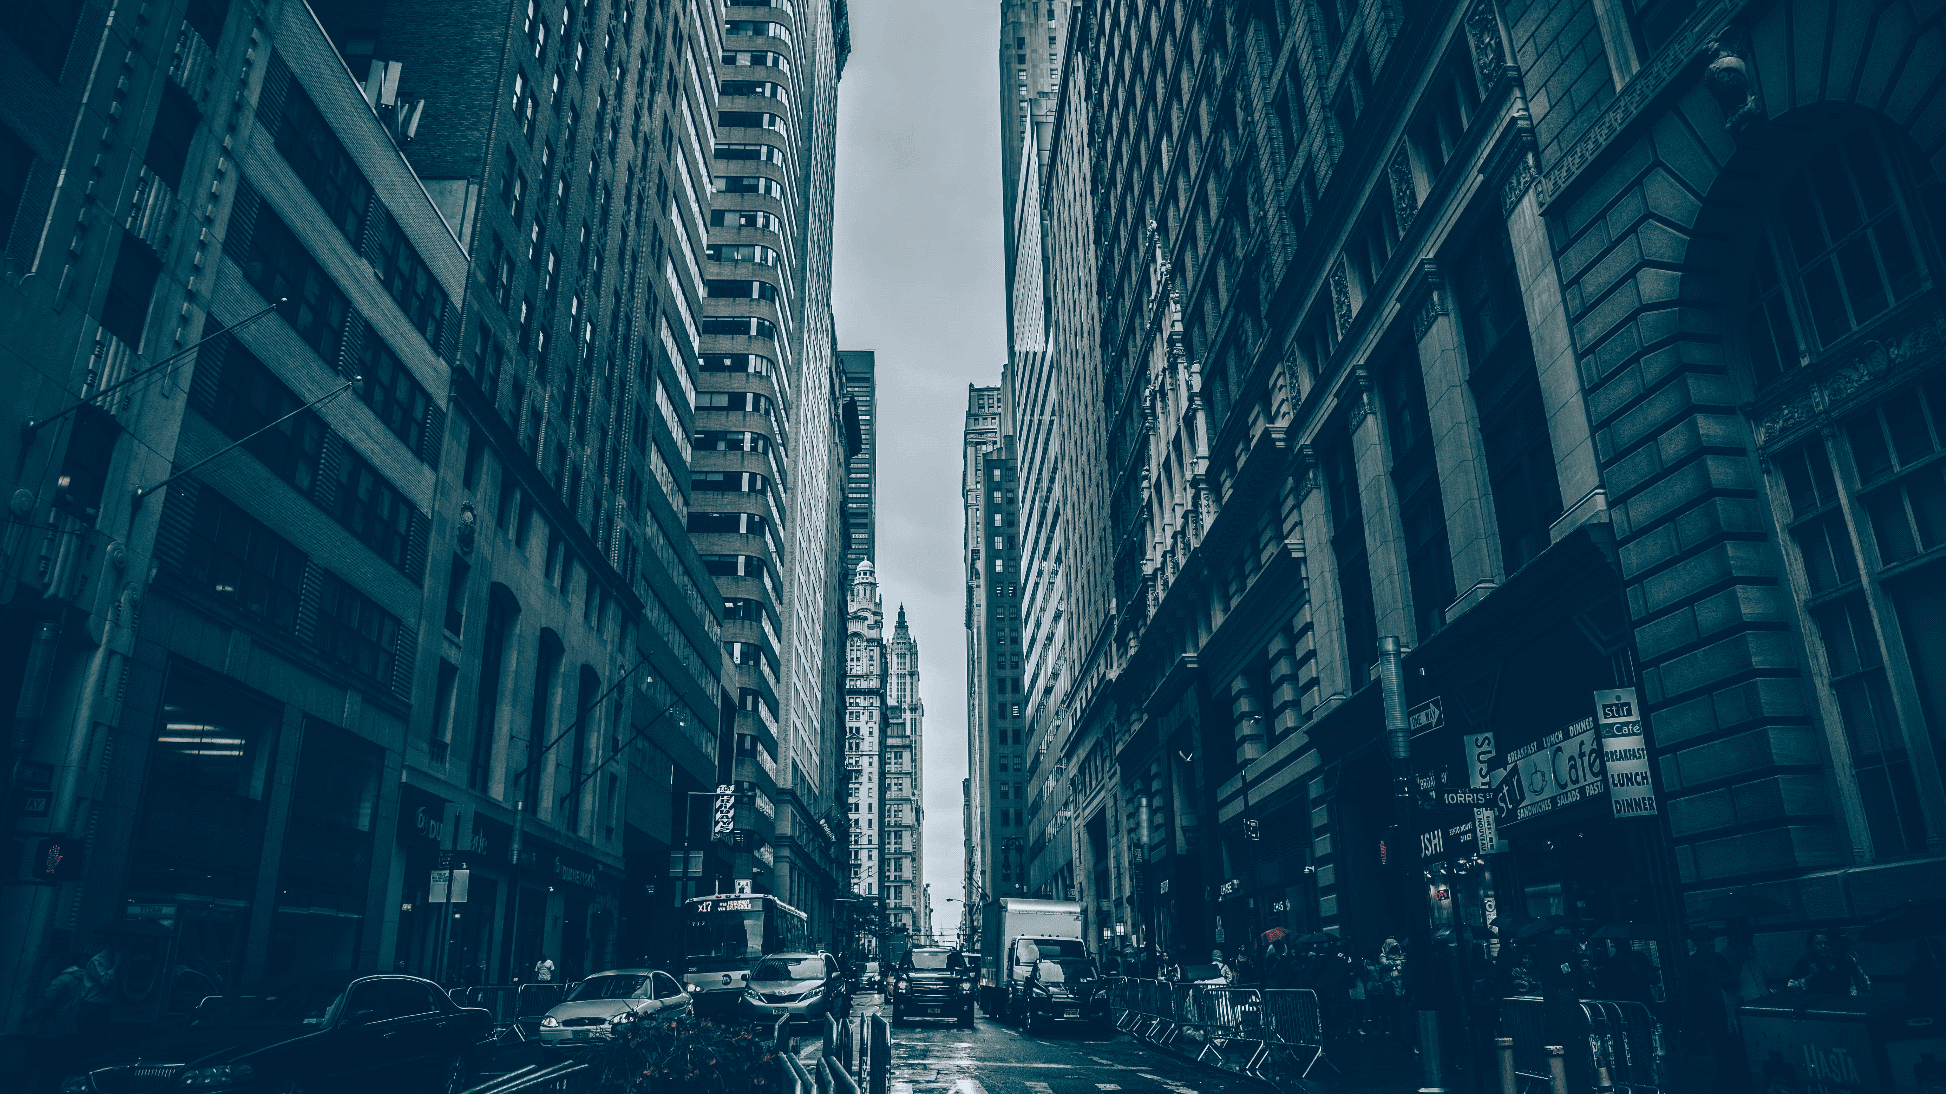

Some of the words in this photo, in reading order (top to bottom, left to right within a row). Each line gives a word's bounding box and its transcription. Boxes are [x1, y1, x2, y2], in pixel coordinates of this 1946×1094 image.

[1411, 714, 1422, 728] ONE
[1425, 708, 1436, 721] WAY
[1605, 704, 1629, 718] stir
[1613, 723, 1640, 735] Café
[1507, 741, 1537, 763] BREAKFAST
[1542, 731, 1563, 747] LUNCH
[1604, 748, 1646, 762] BREAKFAST
[1610, 771, 1649, 788] LUNCH
[1517, 799, 1552, 819] SANDWICHES
[1557, 788, 1580, 807] SALADS
[1613, 797, 1656, 814] DINNER
[698, 901, 712, 913] x17
